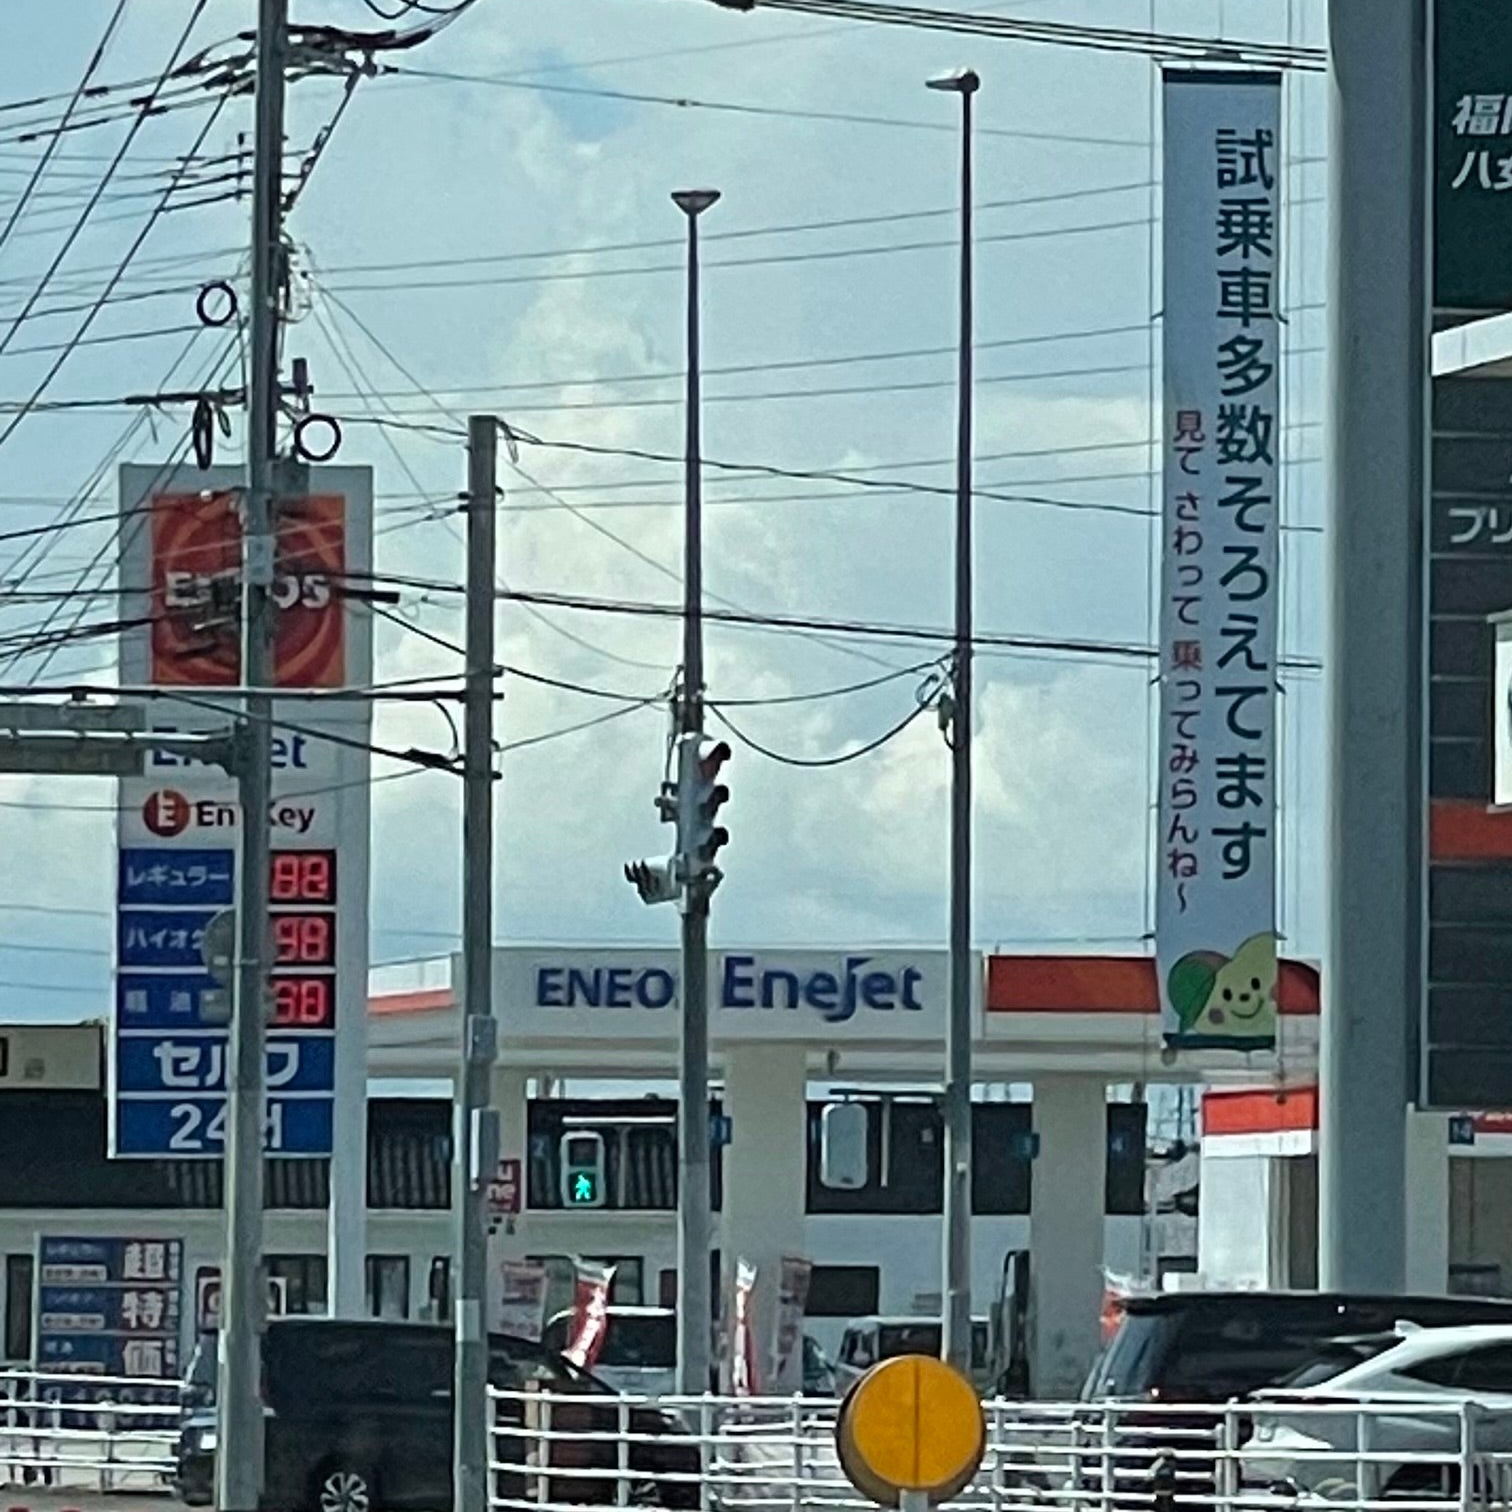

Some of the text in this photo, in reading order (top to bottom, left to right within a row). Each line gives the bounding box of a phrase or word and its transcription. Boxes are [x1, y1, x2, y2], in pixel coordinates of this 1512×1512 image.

[1211, 128, 1274, 880] 試乗車多数そろえてます
[126, 865, 230, 887] レギュラー
[535, 967, 681, 1009] ENEO
